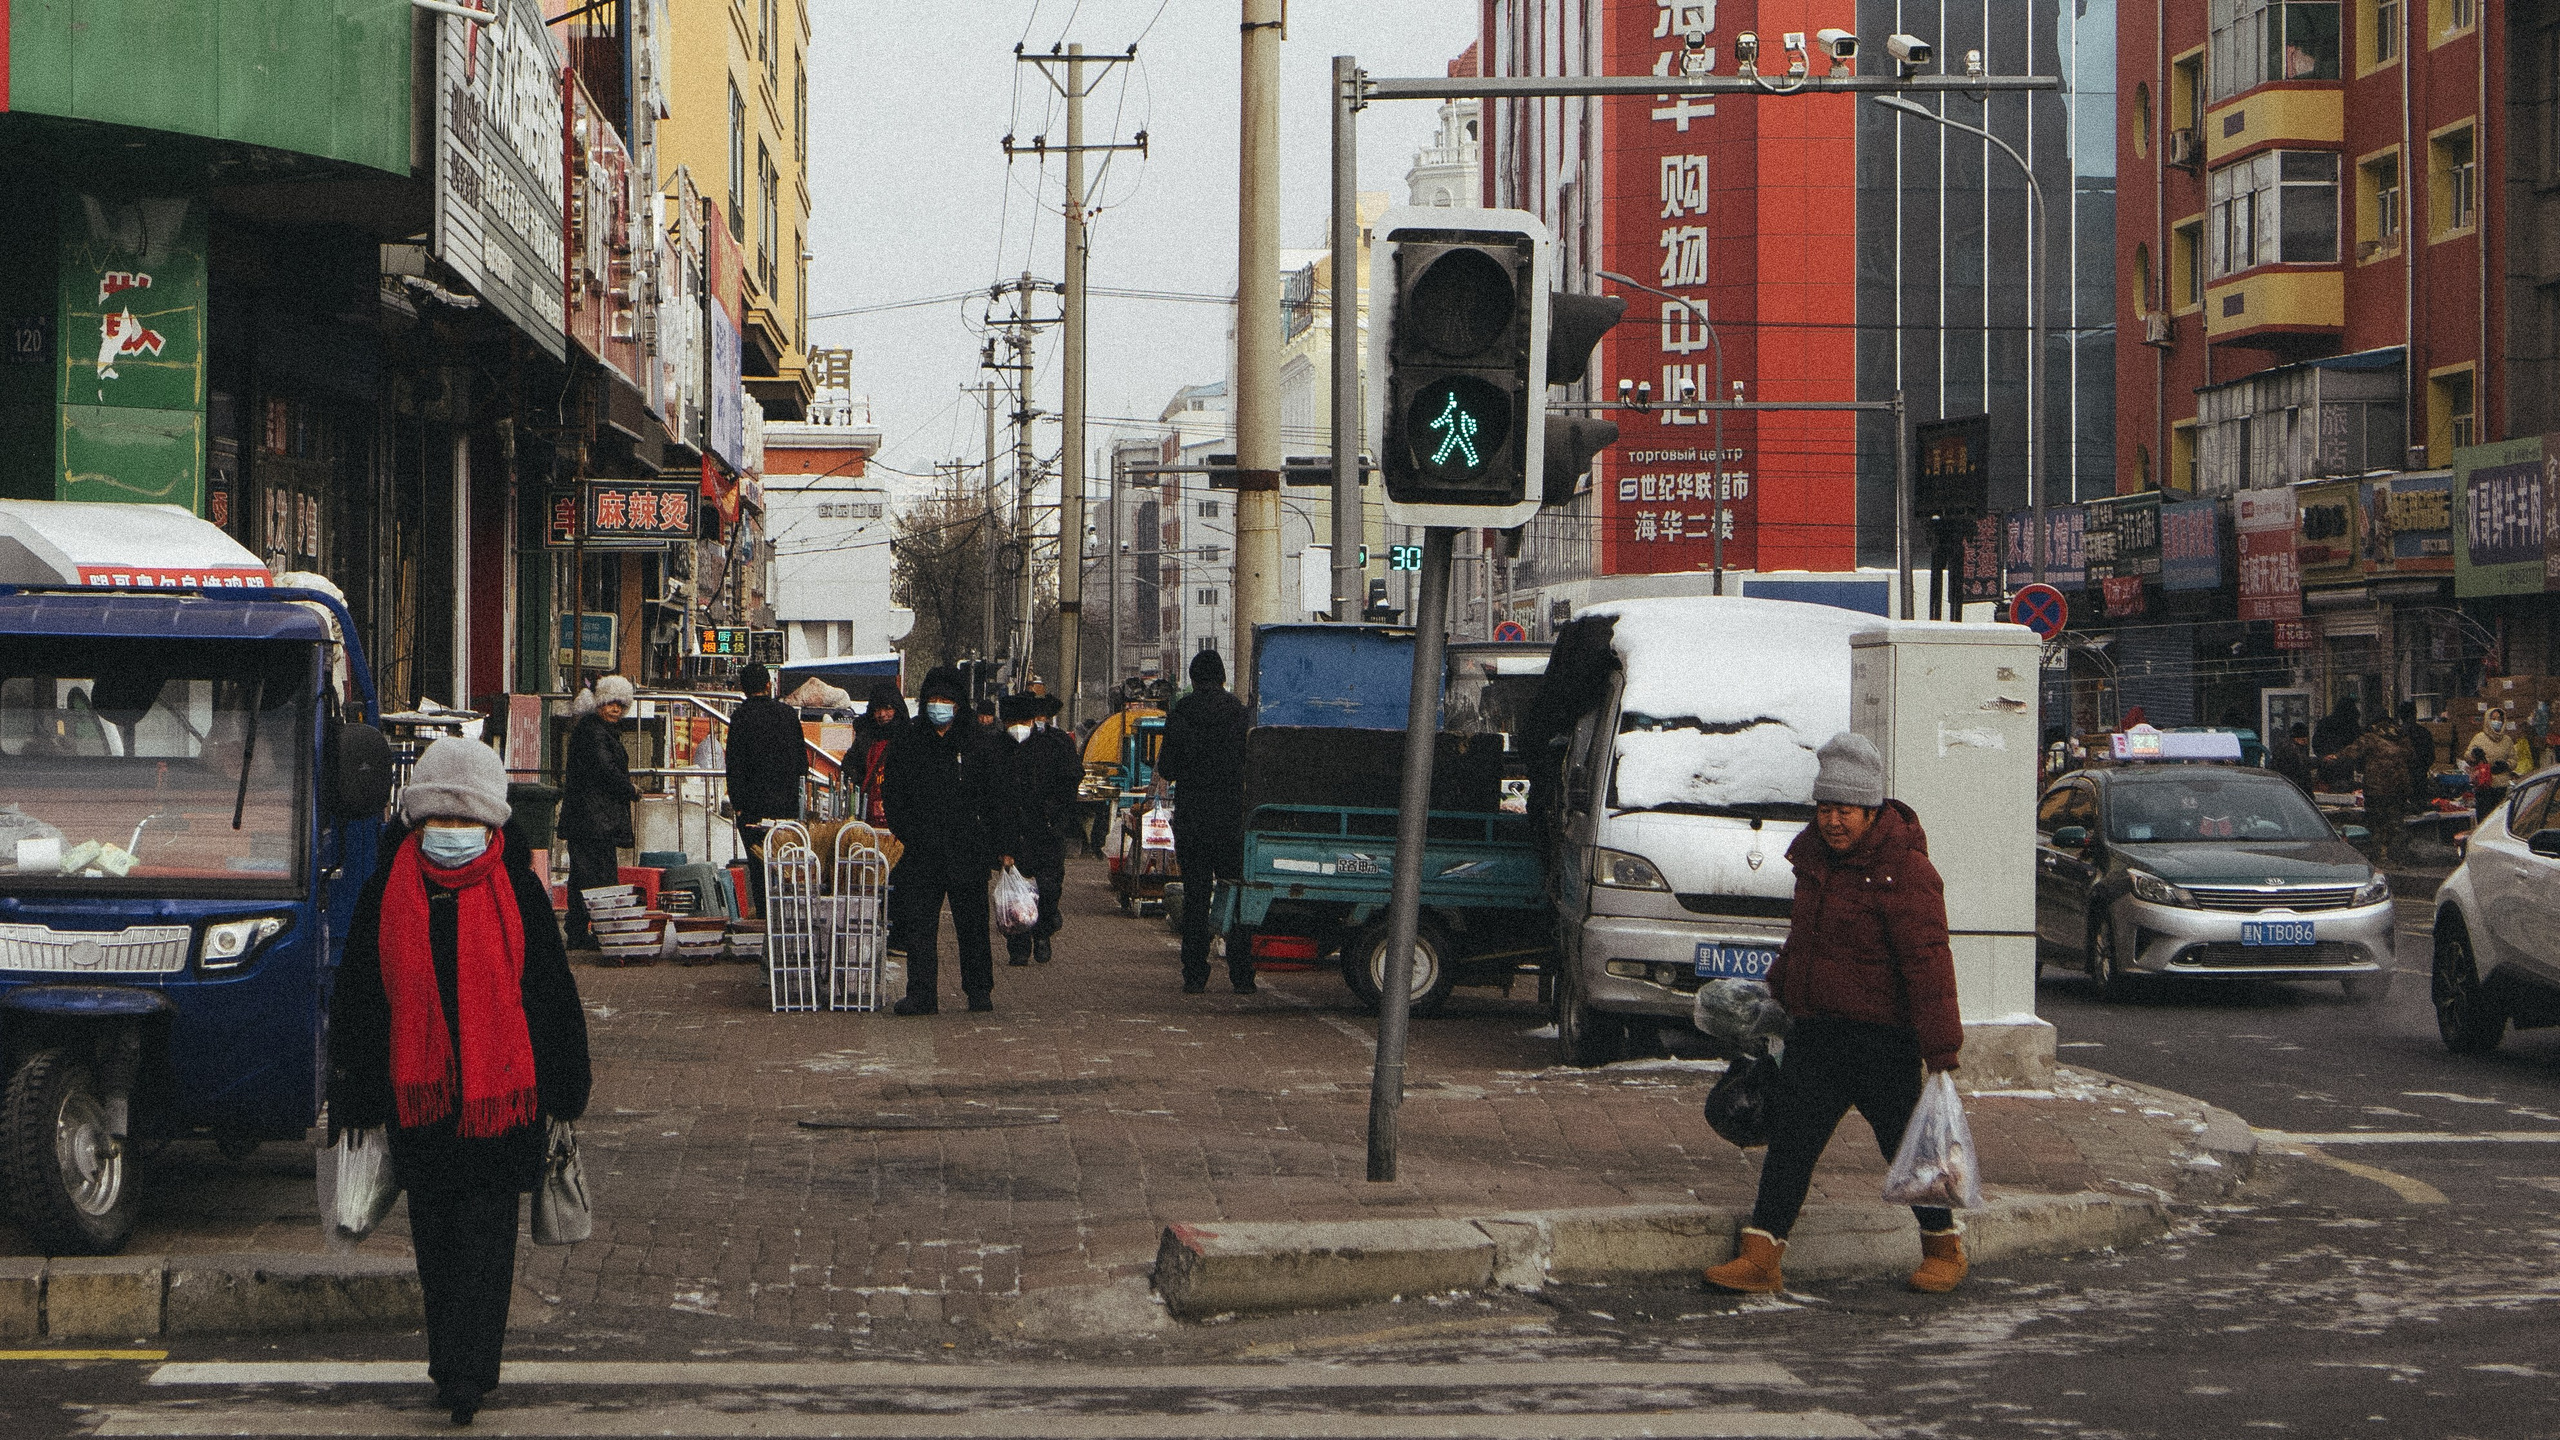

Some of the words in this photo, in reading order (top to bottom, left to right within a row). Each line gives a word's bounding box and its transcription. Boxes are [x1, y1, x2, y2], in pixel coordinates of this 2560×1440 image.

[15, 330, 42, 352] 120
[2322, 404, 2348, 471] 旅店
[1628, 447, 1697, 464] торговый
[1640, 471, 1750, 502] 世纪华联超市
[596, 490, 689, 531] 麻辣烫
[1634, 508, 1735, 542] 海华二楼
[1392, 546, 1421, 571] 30
[702, 630, 717, 653] 香烟
[718, 631, 731, 654] 厨具
[732, 631, 746, 654] 百货
